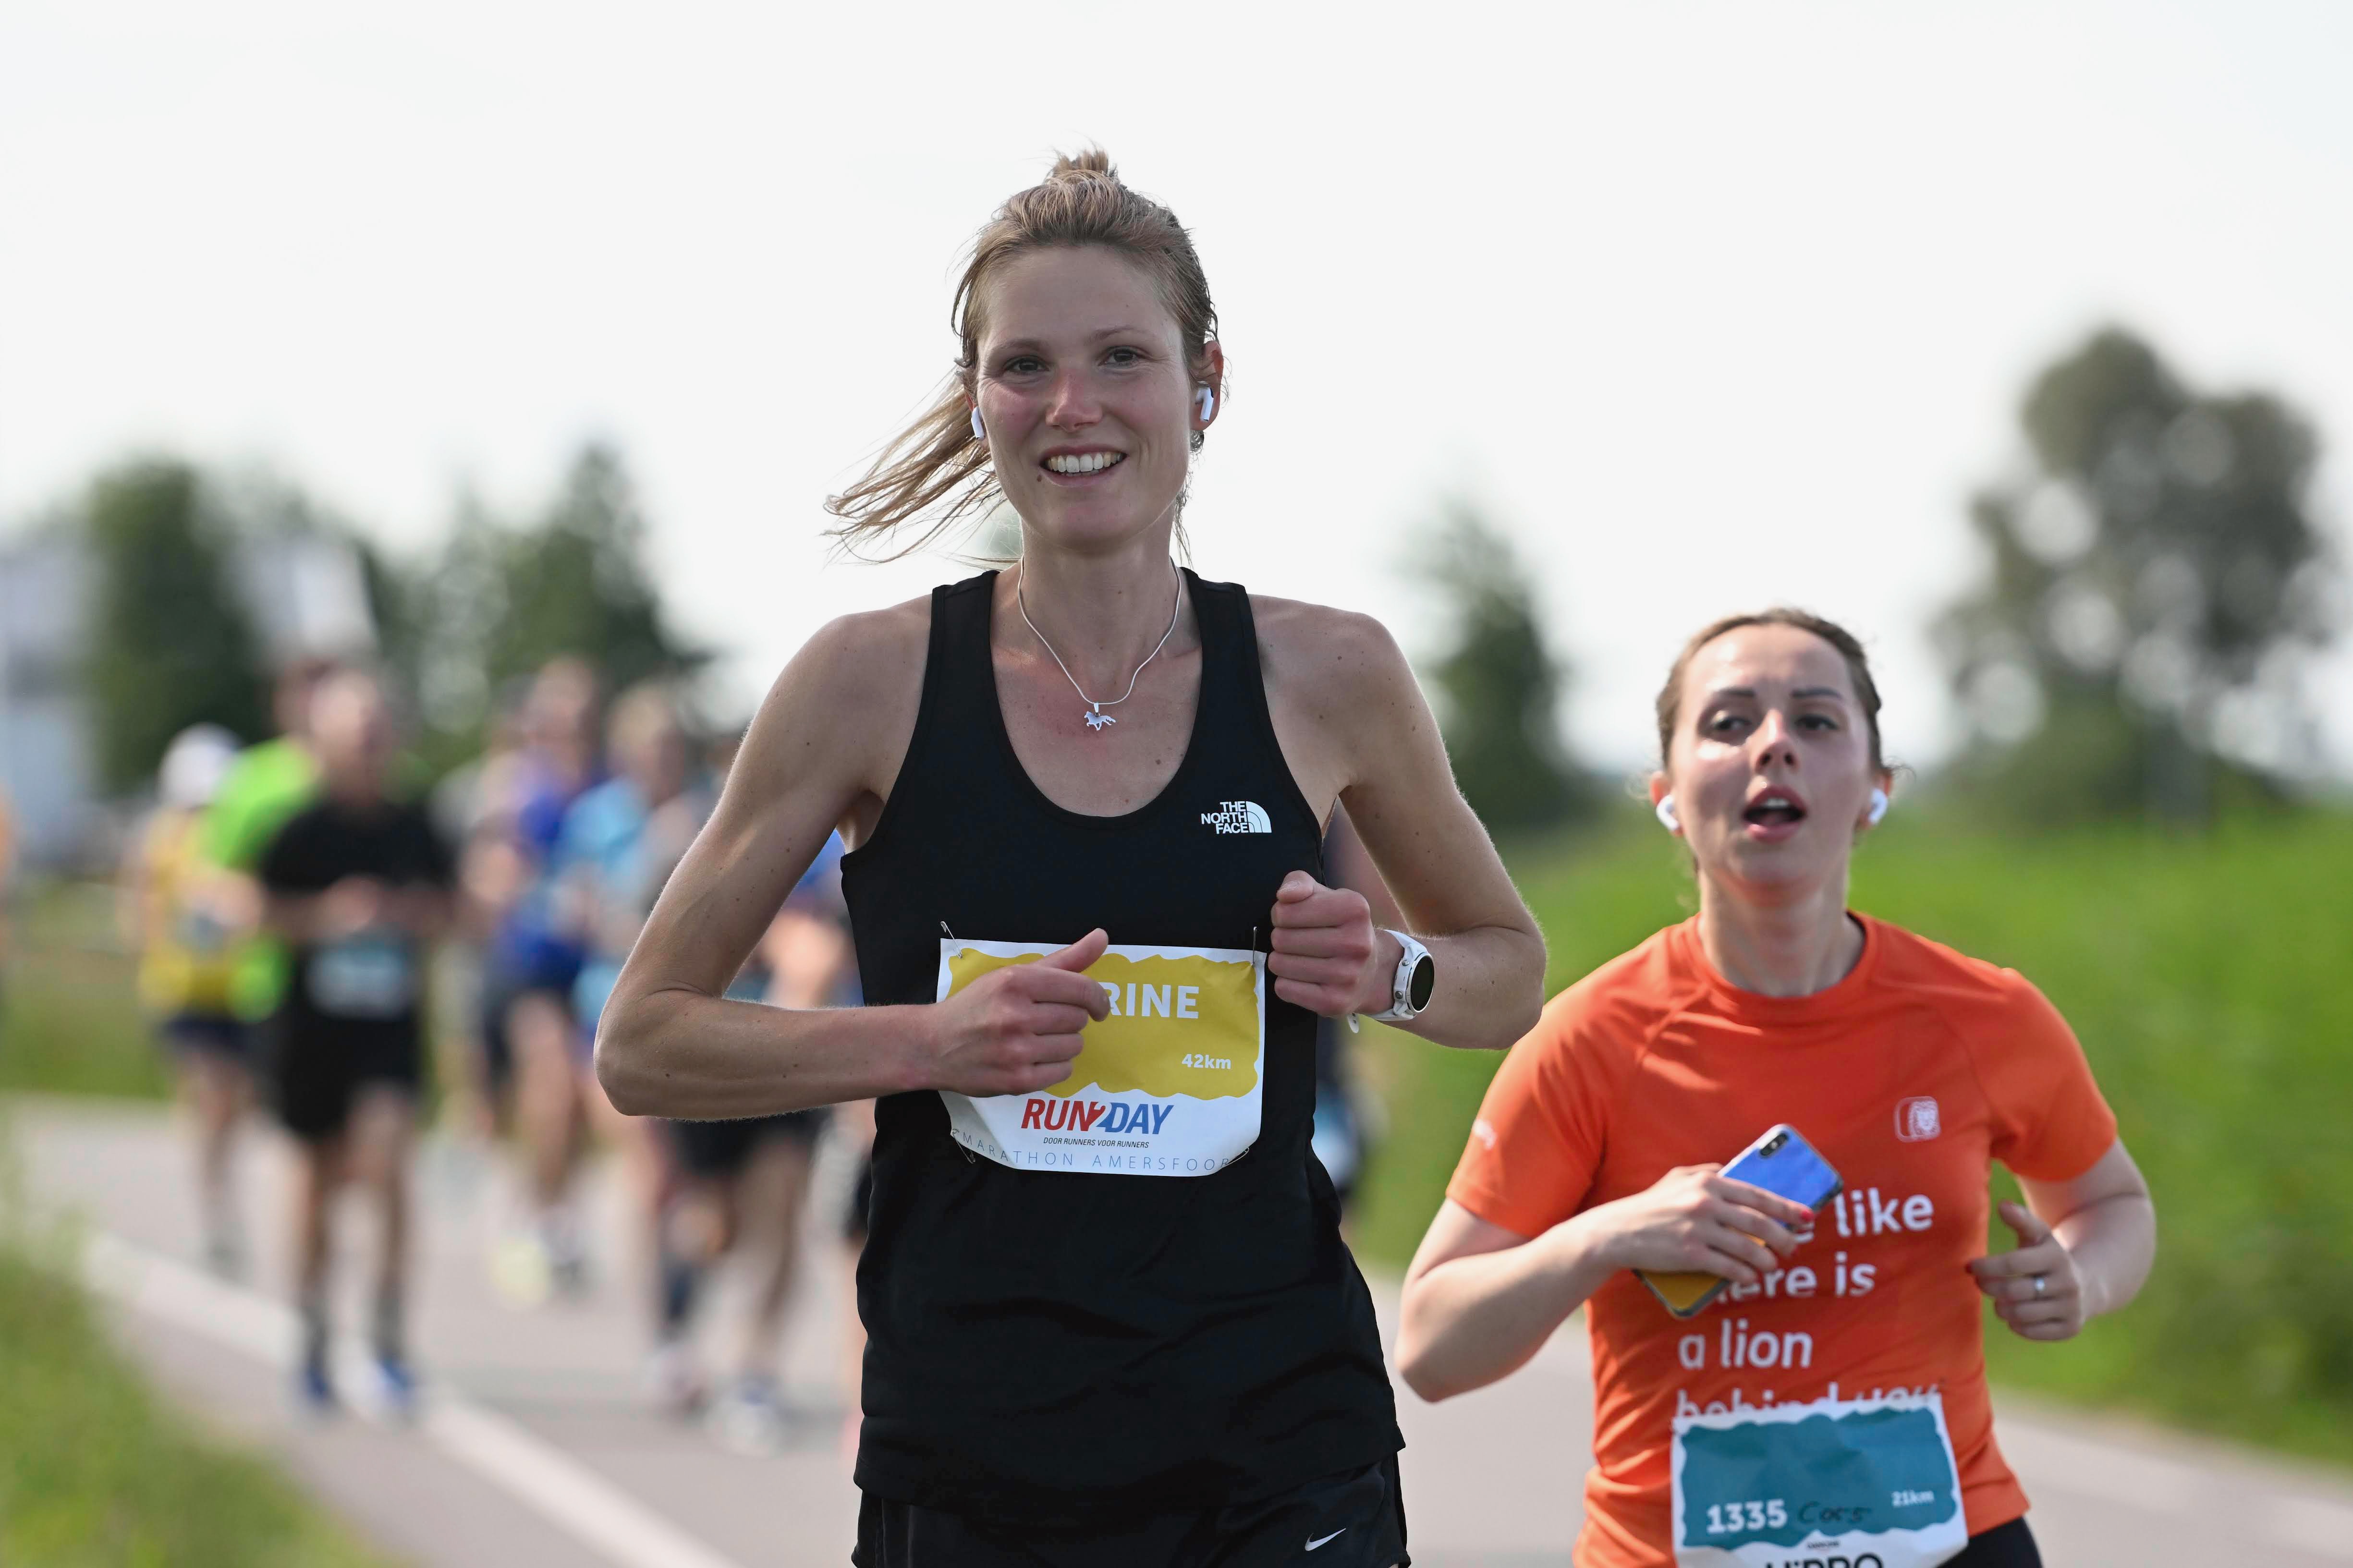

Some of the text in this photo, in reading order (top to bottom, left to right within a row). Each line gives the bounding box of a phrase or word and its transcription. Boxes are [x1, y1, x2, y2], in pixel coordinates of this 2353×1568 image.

[1201, 812, 1247, 824] NORTH
[1220, 801, 1245, 812] THE
[1216, 823, 1249, 834] FACE
[1098, 982, 1199, 1019] RINE
[1182, 1054, 1231, 1070] 42km
[963, 1131, 1229, 1171] MARATHON AMERSFOOR
[1834, 1188, 1934, 1238] like
[1835, 1252, 1877, 1297] is
[1678, 1318, 1813, 1370] a lion
[1707, 1498, 1788, 1533] 1335
